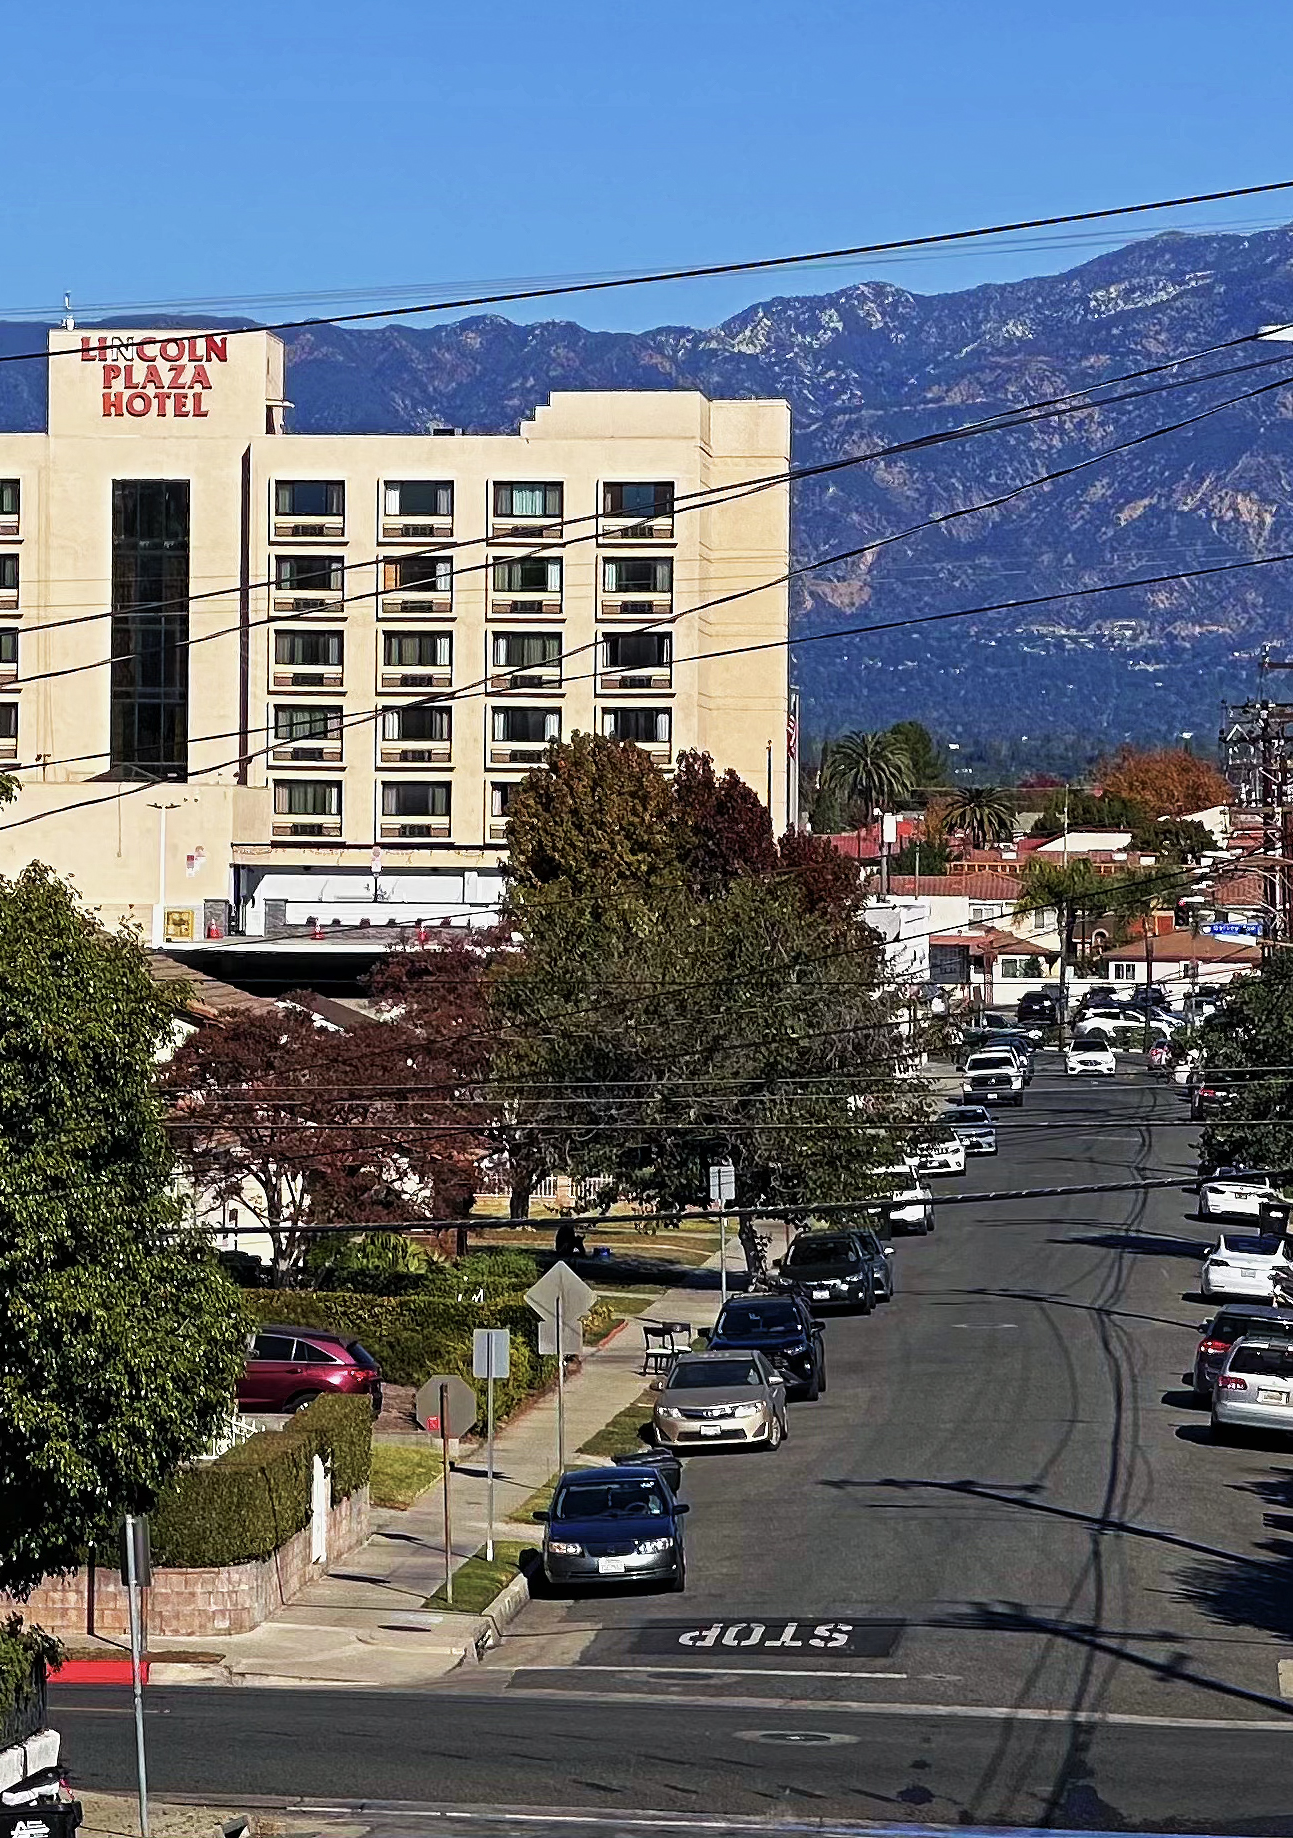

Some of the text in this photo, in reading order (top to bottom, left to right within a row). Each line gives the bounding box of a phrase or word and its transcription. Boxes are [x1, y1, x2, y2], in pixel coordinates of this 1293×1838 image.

[81, 337, 228, 362] LINCOLN
[103, 364, 212, 390] PLAZA
[102, 392, 209, 417] HOTEL
[678, 1622, 853, 1648] STOP
